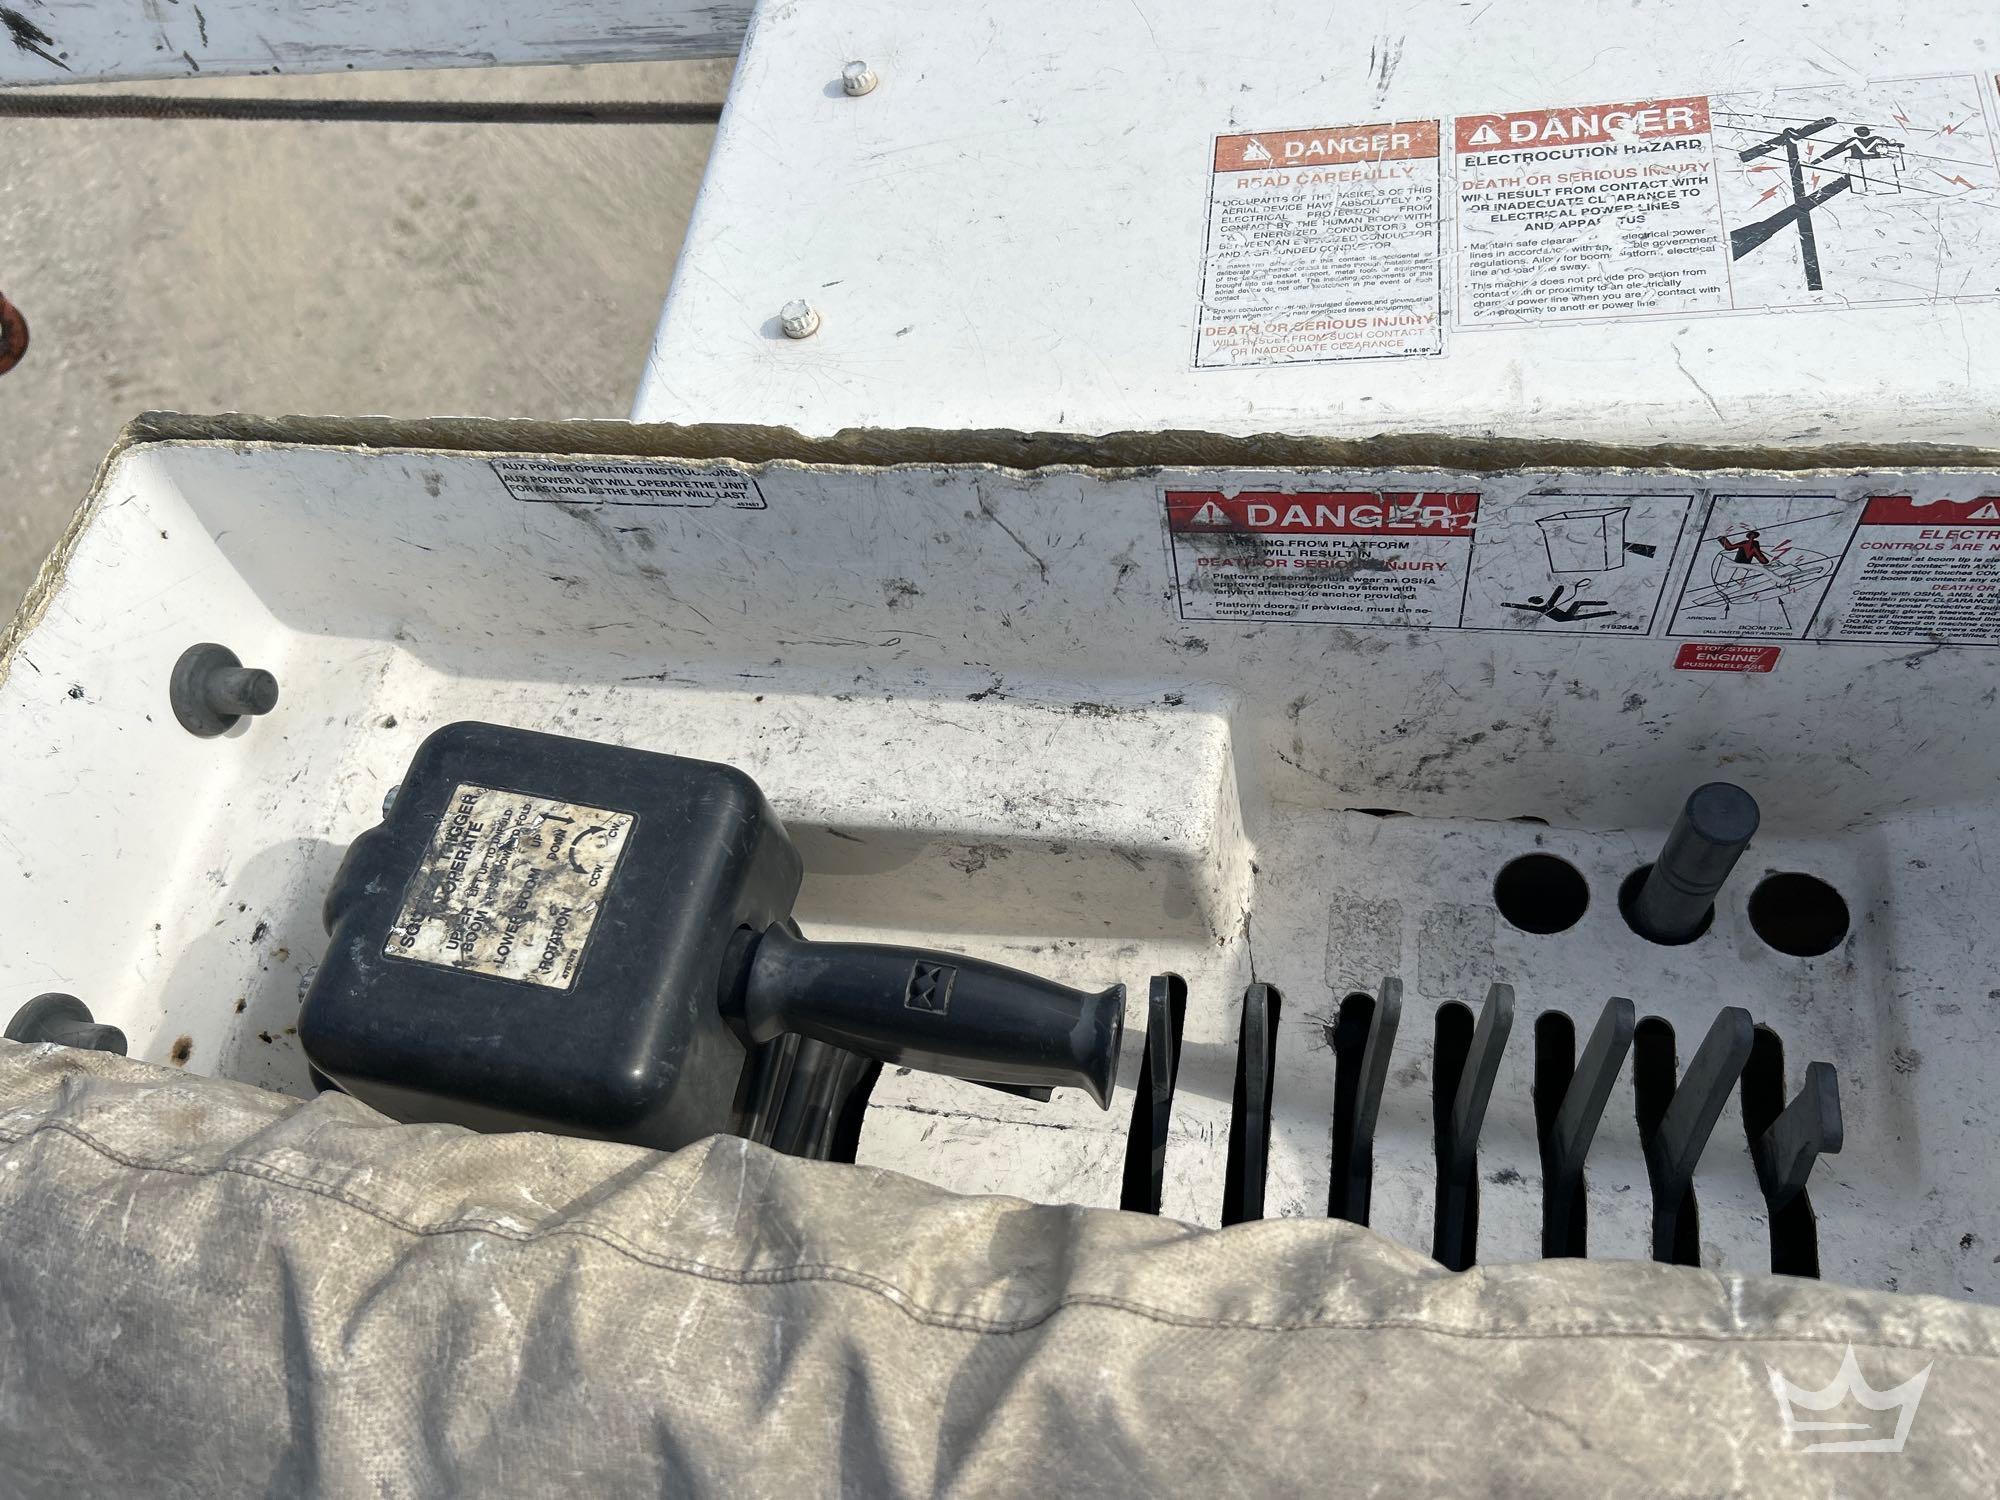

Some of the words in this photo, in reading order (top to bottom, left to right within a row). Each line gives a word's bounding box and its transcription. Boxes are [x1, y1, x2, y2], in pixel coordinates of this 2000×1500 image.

[1284, 133, 1410, 158] DANGER
[1465, 146, 1617, 167] ELECTROCUTION
[1624, 139, 1702, 154] HAZARD
[1296, 167, 1414, 185] CAREFULLY
[1463, 177, 1520, 190] DEATH
[1526, 175, 1551, 186] OR
[1557, 168, 1638, 183] SERIOUS
[1408, 186, 1432, 194] THIS
[1498, 188, 1551, 200] RESULT
[1555, 185, 1595, 196] FROM
[1600, 179, 1669, 192] CONTACT
[1672, 176, 1708, 187] WITH
[1680, 188, 1700, 197] TO
[1400, 204, 1432, 212] FROM
[1491, 208, 1577, 222] ELECTRICAL
[1404, 212, 1432, 220] WITH
[1525, 221, 1554, 231] AND
[1516, 239, 1538, 247] safe
[1580, 253, 1610, 261] boom
[1540, 278, 1565, 286] does
[1682, 268, 1707, 276] from
[1473, 290, 1509, 299] contact
[1548, 285, 1594, 297] proximity
[1517, 297, 1547, 306] power
[1602, 293, 1621, 301] you
[1657, 287, 1696, 297] contact
[1699, 285, 1721, 294] with
[1602, 301, 1634, 311] power
[1265, 323, 1288, 332] OR
[1373, 315, 1434, 327] INJURY
[1366, 328, 1424, 339] CONTACT
[1251, 343, 1327, 355] INADEQUATE
[503, 463, 527, 471] AUX
[530, 464, 573, 472] POWER
[575, 465, 644, 474] OPERATING
[504, 474, 529, 483] AUX
[530, 476, 574, 484] POWER
[606, 479, 636, 487] WILL
[637, 479, 691, 488] OPERATE
[692, 481, 717, 489] THE
[509, 484, 534, 492] FOR
[552, 486, 587, 494] LONG
[604, 488, 629, 496] THE
[629, 489, 682, 497] BATTERY
[683, 490, 715, 499] WILL
[1247, 504, 1456, 529] DANGER
[1288, 540, 1328, 548] FROM
[1333, 541, 1410, 549] PLATFORM
[1860, 542, 1945, 551] CONTROLS
[1951, 543, 1984, 551] ARE
[1263, 549, 1296, 557] WILL
[1299, 550, 1351, 558] RESULT
[1263, 559, 1288, 568] OR
[1401, 577, 1436, 585] OSHA
[1321, 591, 1361, 599] anchor
[1215, 601, 1260, 609] Platform
[1696, 653, 1759, 662] ENGINE
[608, 822, 621, 838] CW
[531, 834, 543, 848] UP
[546, 828, 567, 861] DOWN
[589, 864, 604, 887] CCW
[493, 915, 523, 965] LOWER
[516, 867, 542, 910] BOOM
[446, 906, 475, 950] UPER
[461, 910, 488, 953] BOOM
[538, 906, 573, 972] ROTATION
